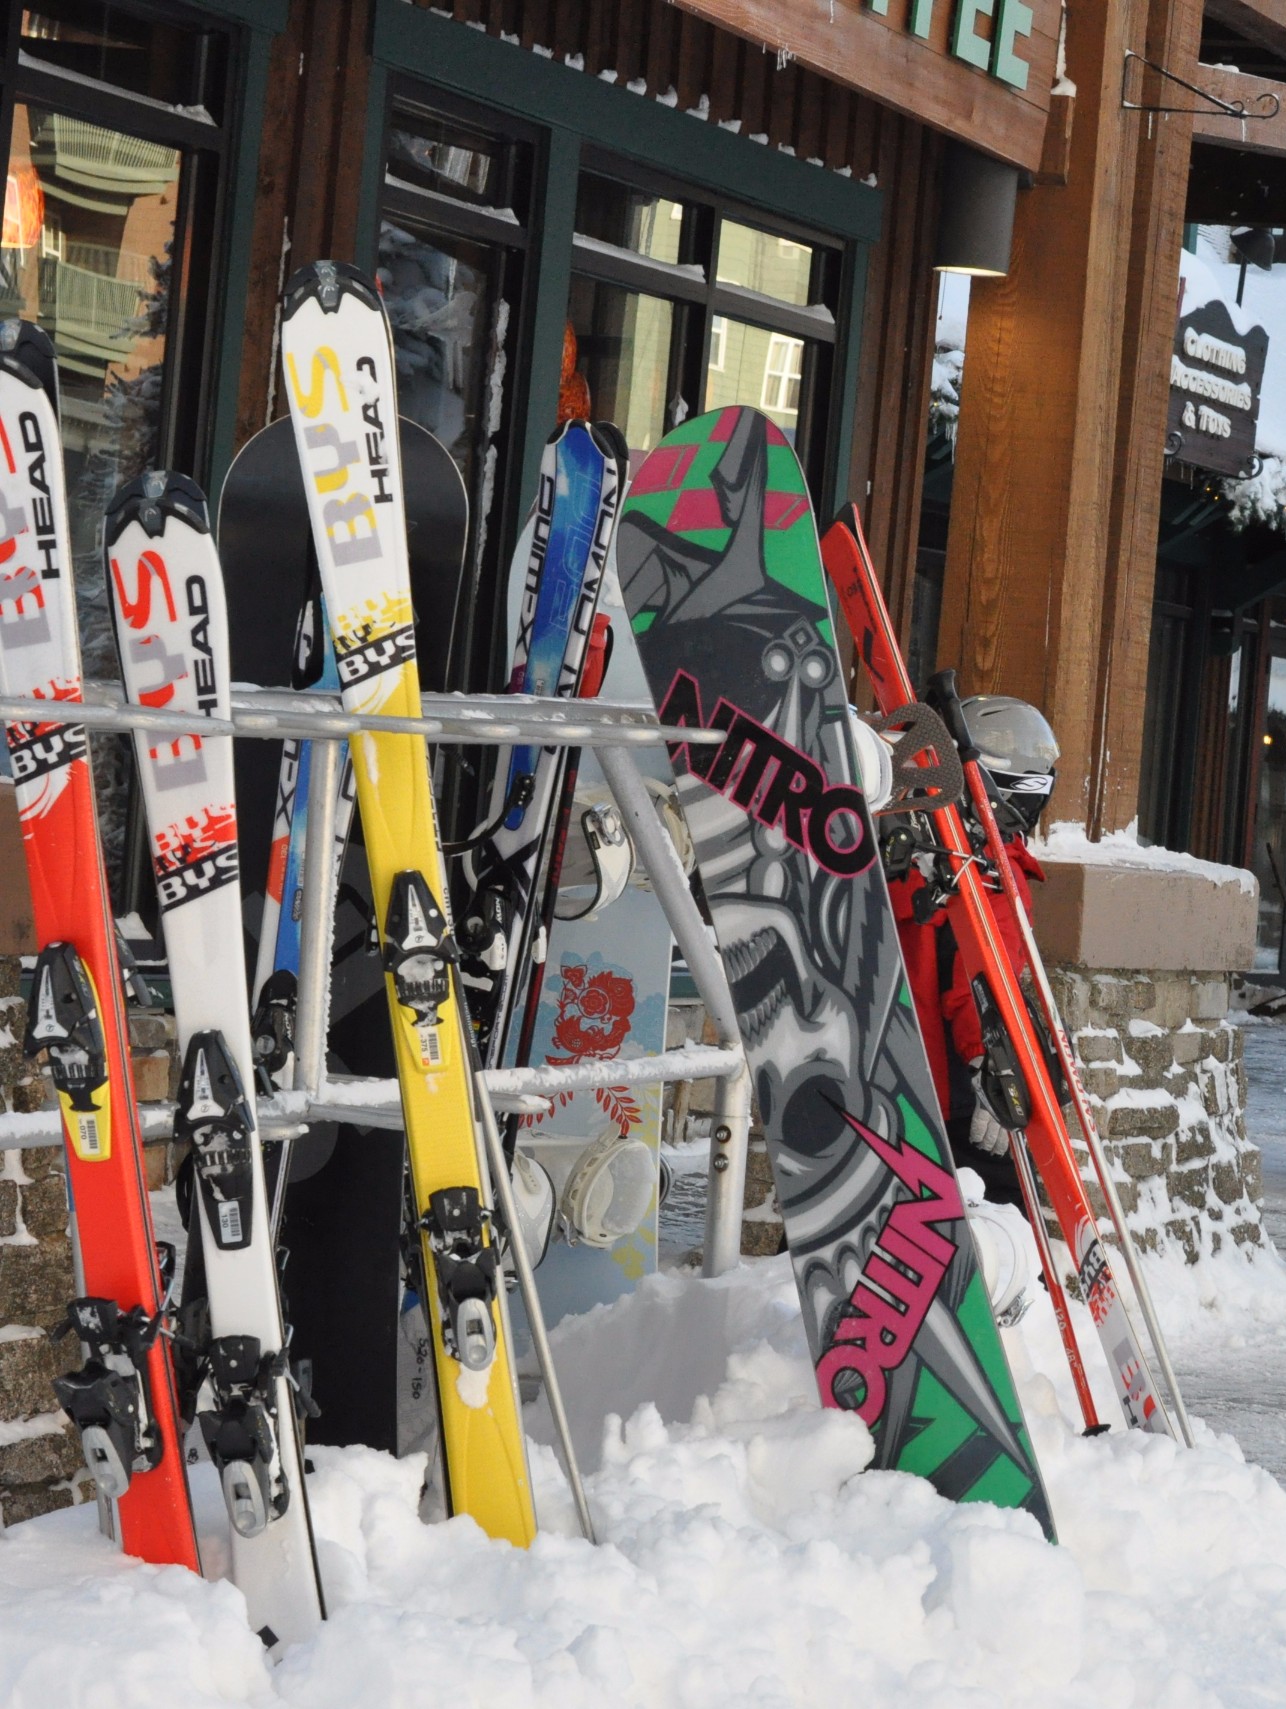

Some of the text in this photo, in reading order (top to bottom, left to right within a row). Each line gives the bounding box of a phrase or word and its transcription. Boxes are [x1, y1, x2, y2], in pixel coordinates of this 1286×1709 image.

[355, 356, 394, 504] HEAD
[1170, 361, 1252, 411] ACCESSORIES
[1182, 403, 1231, 438] & TOYS
[1184, 331, 1246, 375] CLOTHING
[18, 410, 61, 580] HEAD
[185, 574, 218, 738] HEAD
[657, 669, 877, 879] NITRO
[815, 1090, 968, 1428] NITRO
